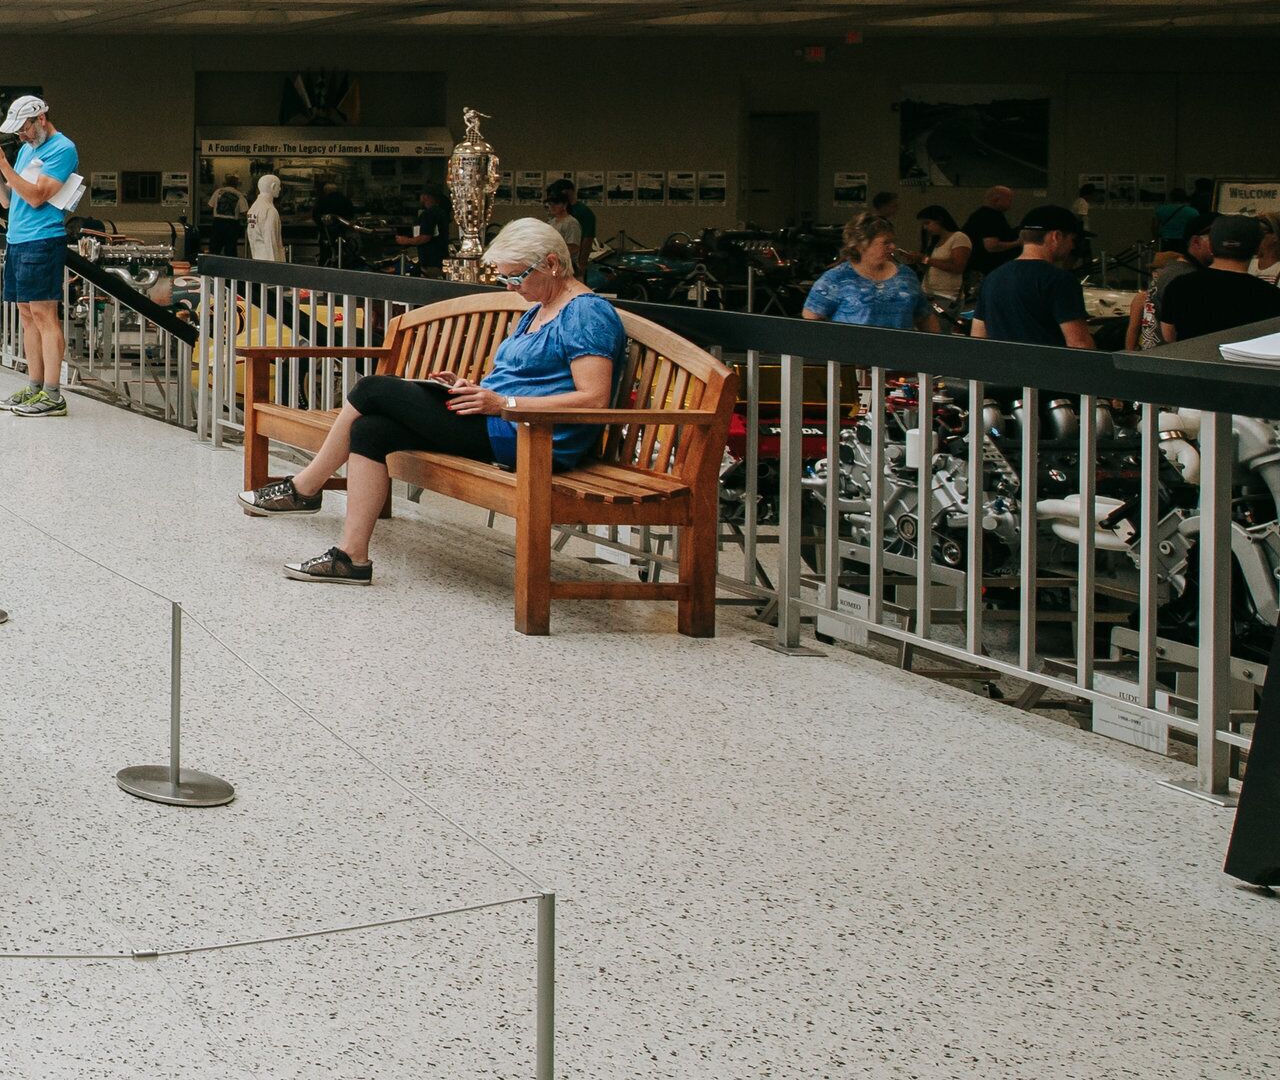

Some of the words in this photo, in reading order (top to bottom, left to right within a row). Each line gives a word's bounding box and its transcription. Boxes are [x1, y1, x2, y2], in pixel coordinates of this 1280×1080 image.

[208, 144, 214, 153] A
[215, 143, 251, 154] Founding
[253, 144, 282, 153] Father:
[283, 144, 297, 153] The
[298, 144, 326, 155] Legacy
[328, 144, 337, 153] of
[338, 144, 362, 153] James
[364, 144, 372, 153] A.
[373, 144, 400, 153] Allison
[1229, 187, 1277, 200] WELCOME
